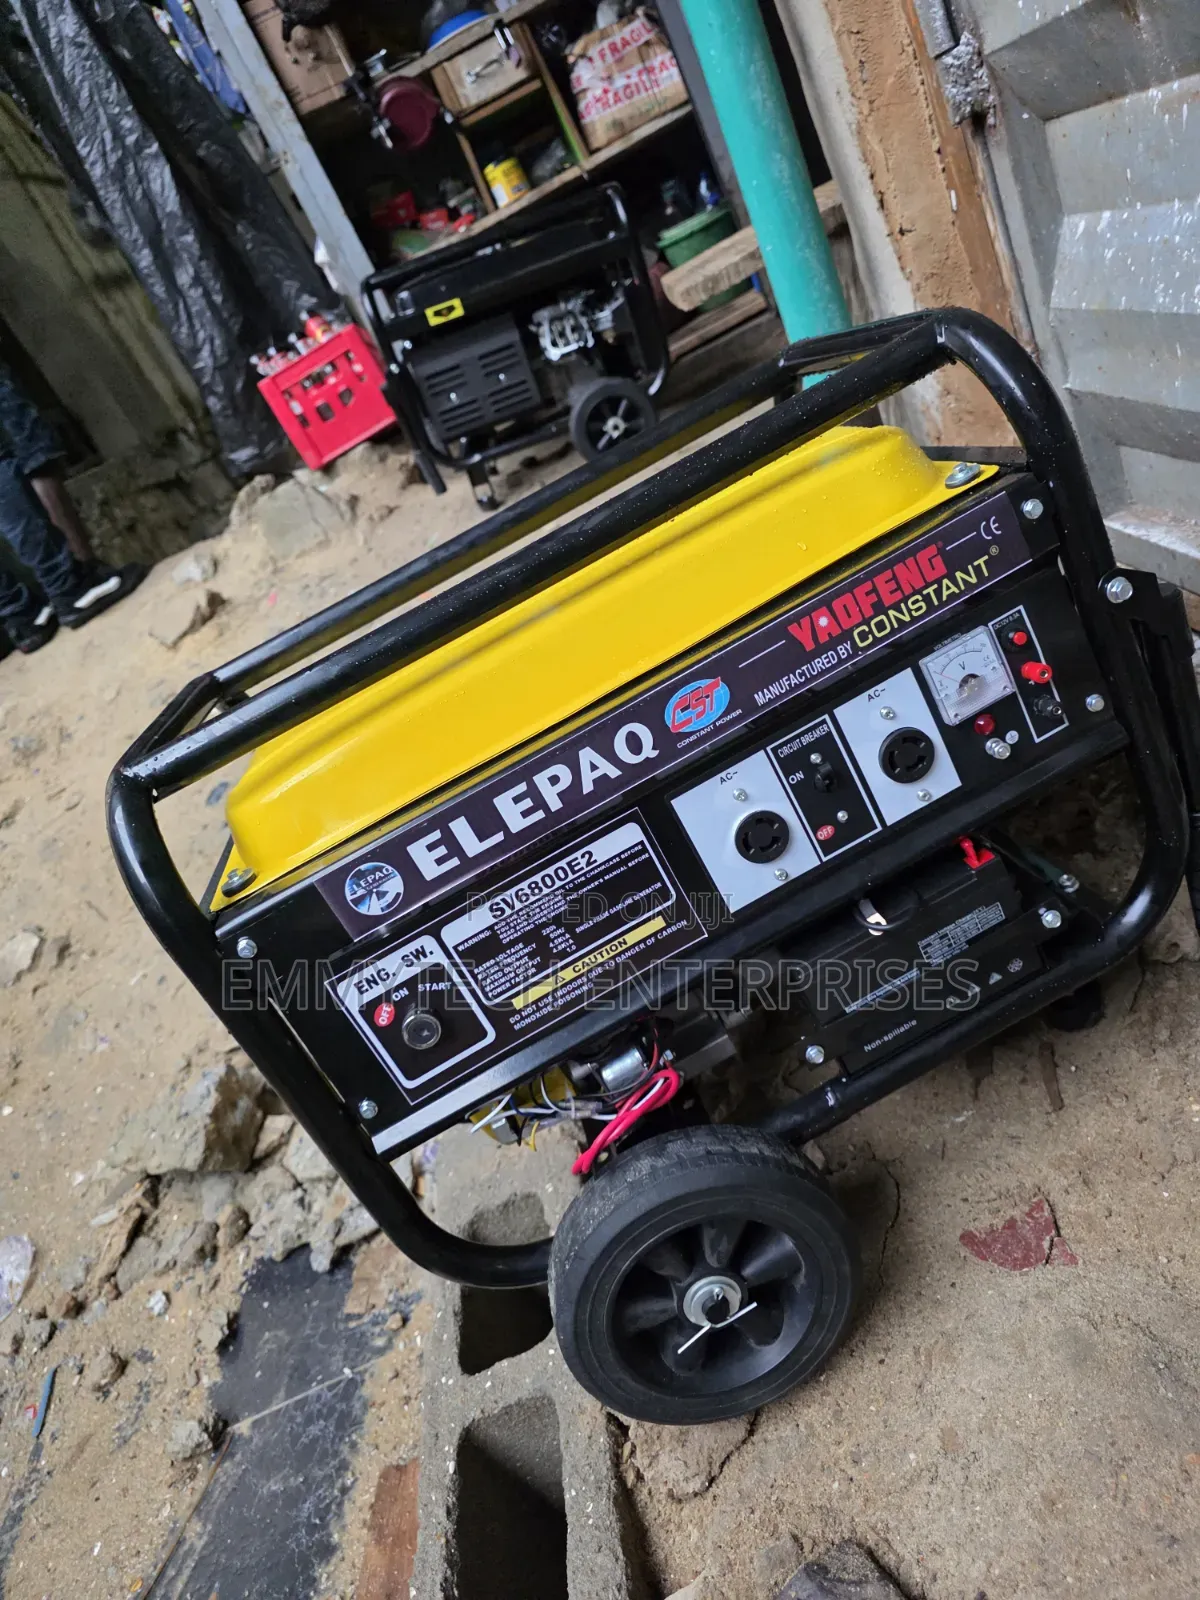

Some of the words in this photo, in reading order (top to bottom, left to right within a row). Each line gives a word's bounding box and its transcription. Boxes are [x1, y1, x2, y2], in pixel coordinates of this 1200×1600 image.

[787, 545, 947, 651] YAOFENG
[755, 651, 837, 705] MANUFACTURED
[837, 641, 852, 659] BY
[670, 676, 722, 733] CST
[677, 724, 714, 748] CONSTANT
[716, 709, 742, 726] POWER
[778, 739, 802, 758] CIRCUIT
[801, 724, 829, 745] BREAKER
[789, 771, 804, 784] ON
[405, 721, 660, 881] ELEPAQ
[817, 826, 832, 840] OFF
[347, 865, 394, 896] ELEPAQ
[489, 851, 596, 919] SV6800E2
[494, 921, 506, 931] ADD
[506, 914, 519, 924] THE
[574, 876, 586, 884] THE
[620, 845, 642, 859] BEFORE
[499, 928, 515, 939] READ
[516, 921, 528, 930] AND
[604, 866, 627, 880] MANUAL
[628, 853, 649, 867] BEFORE
[457, 930, 491, 951] WARNING:
[496, 925, 509, 936] YOU
[510, 914, 528, 927] START
[502, 924, 534, 944] OPERATING
[504, 956, 530, 973] OUTPUT
[575, 920, 594, 933] SINGLE
[572, 938, 628, 973] CAUTION
[354, 967, 396, 995] ENG.
[401, 945, 433, 967] SW.
[474, 959, 496, 974] RATED
[488, 982, 511, 999] POWER
[511, 967, 536, 984] FACTOR
[509, 1014, 521, 1024] DO
[521, 1004, 537, 1017] NOT
[538, 994, 553, 1007] USE
[554, 975, 587, 998] INDOORS
[588, 967, 604, 979] DUE
[604, 960, 615, 970] TO
[615, 943, 646, 963] DANGER
[646, 936, 655, 946] OF
[657, 920, 689, 939] CARBON
[391, 987, 409, 1001] ON
[418, 981, 452, 992] START
[514, 1004, 554, 1030] MONOXIDE
[553, 982, 594, 1009] POISONING
[378, 1003, 393, 1025] OFF
[864, 1020, 917, 1052] Non-spillable
